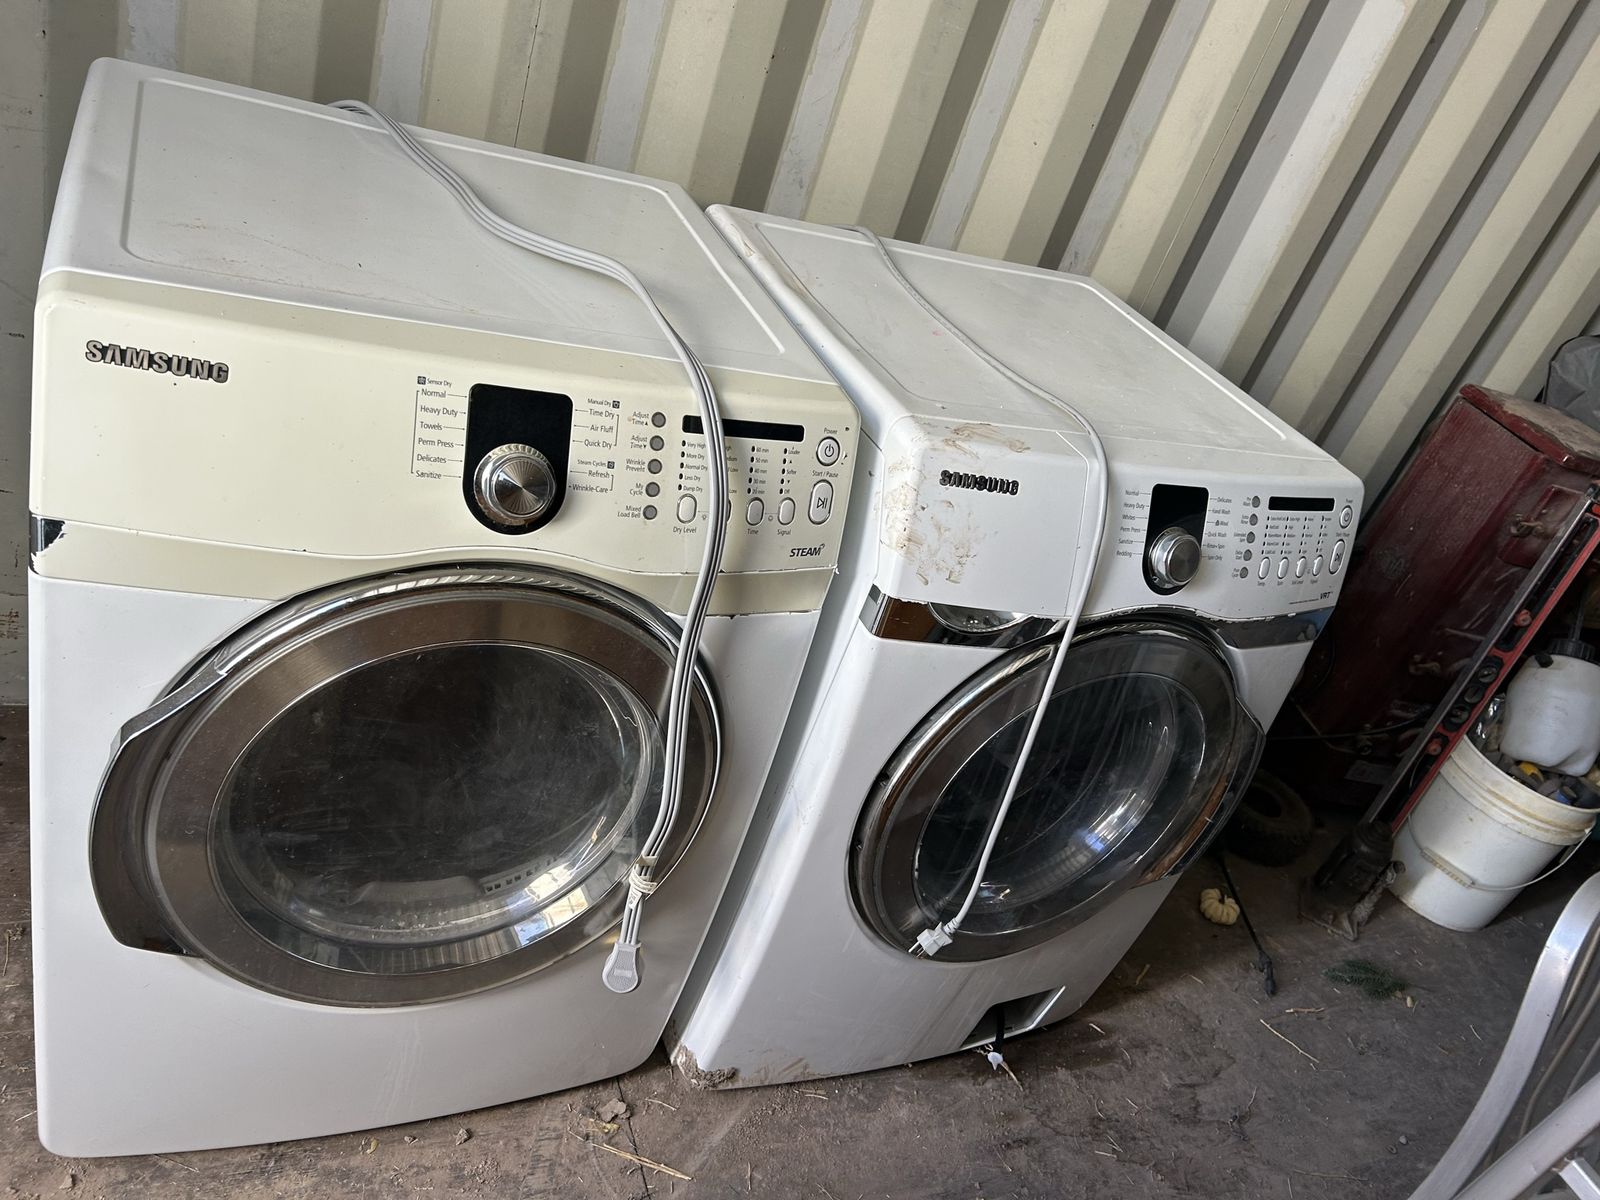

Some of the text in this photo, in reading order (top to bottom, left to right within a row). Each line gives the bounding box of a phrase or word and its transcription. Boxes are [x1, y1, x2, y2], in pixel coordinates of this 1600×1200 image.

[85, 340, 229, 384] SAMSUNG
[427, 378, 452, 388] Sensor Dry
[421, 389, 447, 398] Normal
[587, 398, 612, 408] Manual Dry
[420, 405, 459, 418] Heavy Duty
[589, 408, 615, 420] Time Dry
[633, 412, 649, 420] Adjust
[419, 421, 443, 431] Towels
[632, 418, 645, 426] Time
[600, 425, 614, 433] Fluff
[823, 427, 838, 435] Power
[418, 437, 455, 449] Perm Press
[631, 435, 647, 443] Adjust
[584, 439, 613, 451] Quick Dry
[630, 441, 643, 449] Time
[417, 454, 446, 463] Delicates
[697, 454, 706, 462] Dry
[415, 470, 442, 480] Sanitize
[588, 470, 610, 479] Refresh
[811, 470, 823, 478] Start
[826, 471, 839, 479] Pause
[939, 469, 1020, 496] SAMSUNG
[572, 483, 609, 494] Wrinkle-Care
[630, 489, 644, 497] Cycle
[625, 505, 642, 513] Mixed
[672, 526, 698, 535] Dry Level
[747, 528, 760, 536] Time
[777, 529, 792, 537] Signal
[789, 547, 821, 557] STEAM
